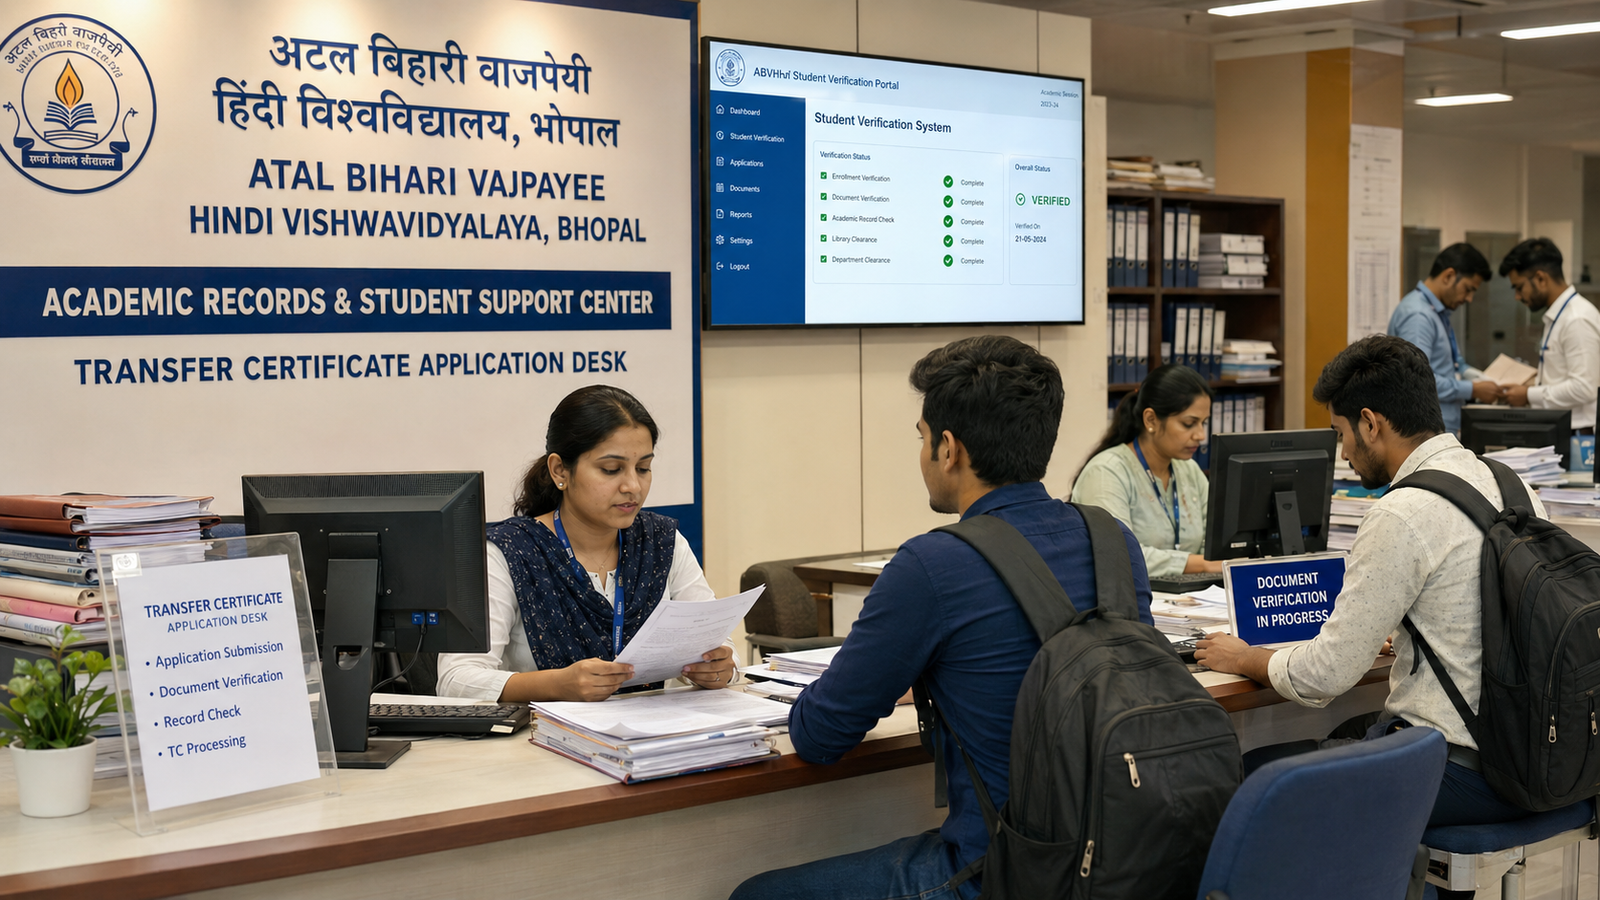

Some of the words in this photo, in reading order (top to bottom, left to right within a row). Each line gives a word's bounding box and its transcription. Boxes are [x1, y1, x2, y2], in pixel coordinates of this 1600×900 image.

[269, 36, 359, 75] अटल
[368, 33, 468, 86] बिहारी
[476, 51, 592, 95] वाजपेयी
[793, 71, 826, 83] Student
[828, 74, 873, 87] Verification
[875, 79, 899, 90] Portal
[212, 77, 287, 131] हिंदी
[296, 83, 520, 148] विश्वविद्यालय,
[530, 103, 621, 148] भोपाल
[730, 107, 760, 116] Dashboard
[815, 112, 855, 126] Student
[857, 115, 913, 130] Verification
[916, 120, 951, 134] System
[730, 132, 753, 140] Student
[753, 134, 785, 142] Verification
[730, 159, 764, 167] Applications
[820, 151, 852, 159] Verification
[1015, 163, 1033, 171] Overall
[248, 158, 334, 191] ATAL
[347, 163, 456, 196] BIHARI
[468, 168, 605, 201] VAJPAYEE
[730, 184, 760, 192] Documents
[960, 179, 984, 187] Complete
[832, 193, 860, 201] Document
[1032, 195, 1070, 206] VERIFIED
[730, 211, 752, 219] Reports
[859, 215, 877, 223] Record
[960, 218, 984, 226] Complete
[190, 205, 273, 235] HINDI
[282, 208, 549, 245] VISHWAVIDYALAYA,
[558, 216, 646, 242] BHOPAL
[730, 237, 753, 246] Settings
[1015, 235, 1046, 243] 21-05-2024
[730, 263, 750, 271] Logout
[960, 257, 984, 265] Complete
[42, 287, 193, 317] ACADEMIC
[204, 287, 326, 315] RECORDS
[334, 288, 352, 314] &
[360, 288, 472, 314] STUDENT
[479, 289, 574, 314] SUPPORT
[580, 290, 653, 314] CENTER
[74, 357, 233, 385] TRANSFER
[244, 354, 410, 380] CERTIFICATE
[419, 352, 563, 376] APPLICATION
[573, 351, 627, 373] DESK
[1257, 572, 1318, 589] DOCUMENT
[144, 599, 211, 618] TRANSFER
[214, 592, 283, 610] CERTIFICATE
[1252, 590, 1327, 608] VERIFICATION
[167, 616, 237, 633] APPLICATION
[241, 612, 268, 624] DESK
[1257, 615, 1269, 628] IN
[1271, 609, 1328, 627] PROGRESS
[156, 649, 221, 670] Application
[224, 641, 283, 658] Submission
[159, 679, 220, 698] Document
[222, 670, 283, 688] Verification
[164, 710, 205, 728] Record
[208, 705, 241, 721] Check
[167, 744, 184, 758] TC
[187, 736, 246, 754] Processing
